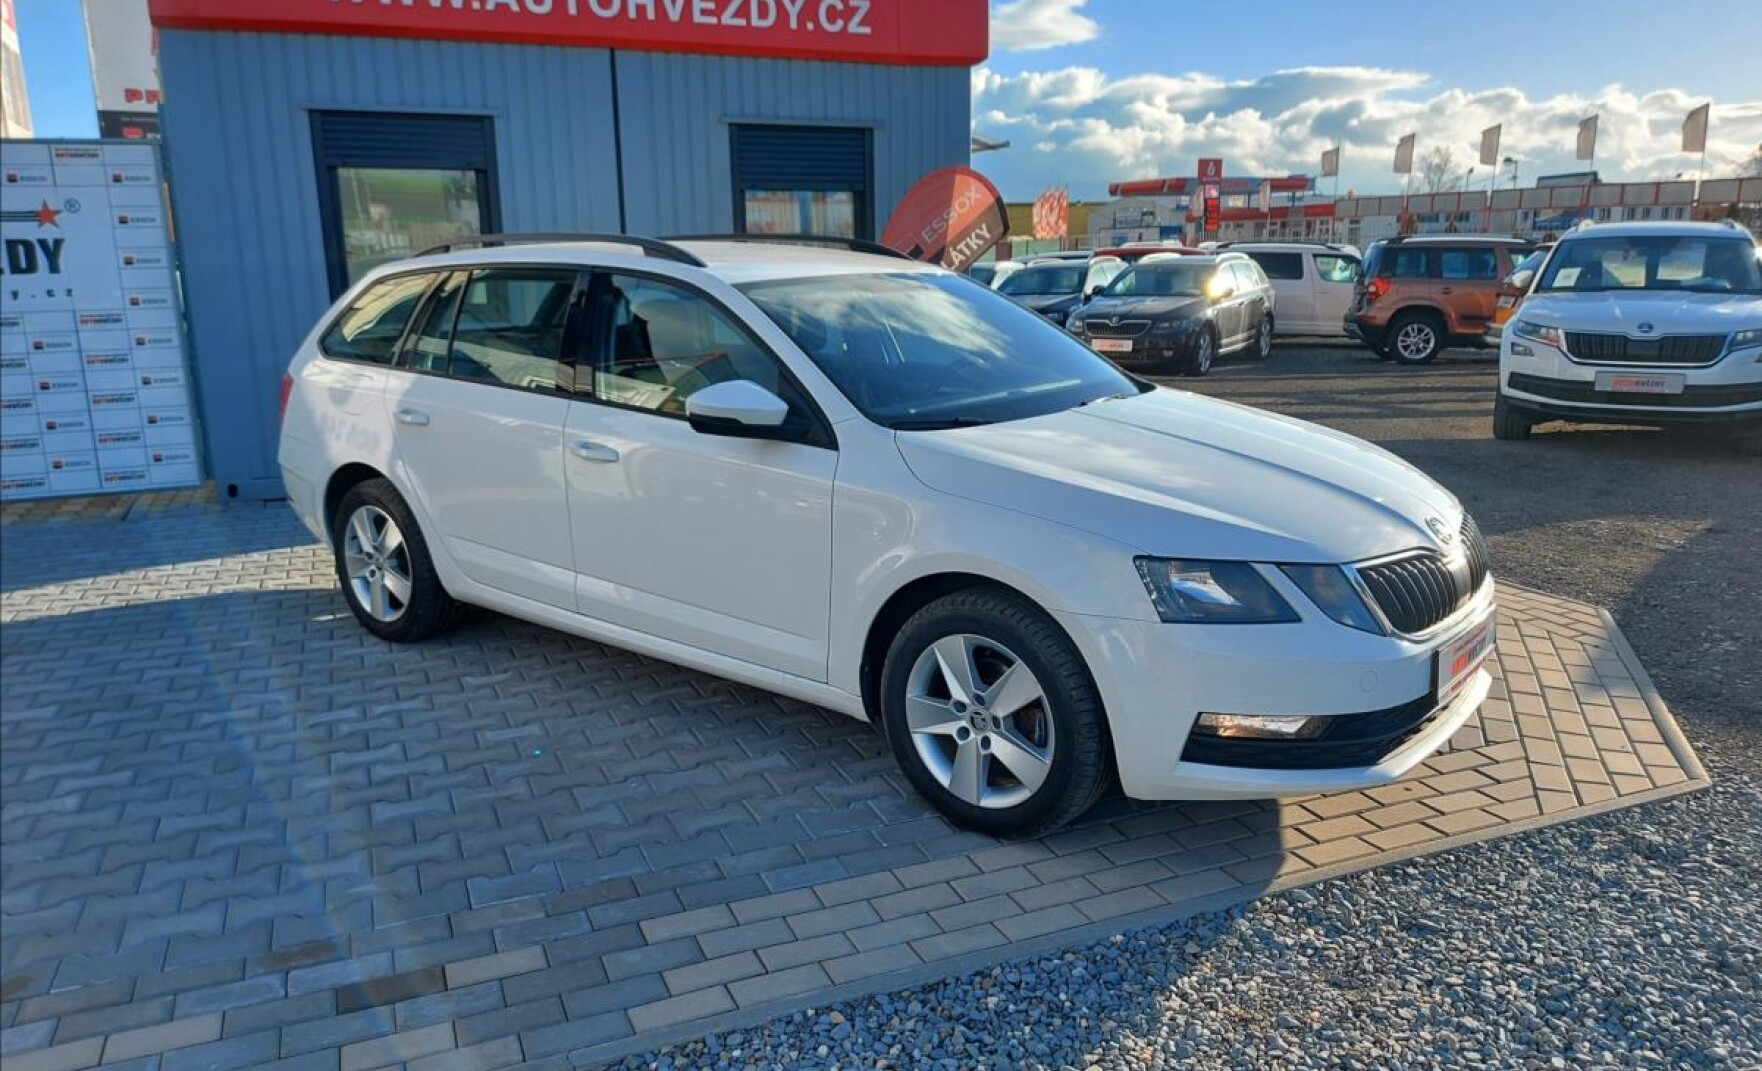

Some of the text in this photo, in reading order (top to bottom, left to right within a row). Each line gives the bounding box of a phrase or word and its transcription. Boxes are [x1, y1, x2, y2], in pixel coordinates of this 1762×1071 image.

[327, 0, 872, 34] .UTOHVEZDY.CZ
[921, 184, 983, 242] ESSOX
[0, 238, 65, 274] DY
